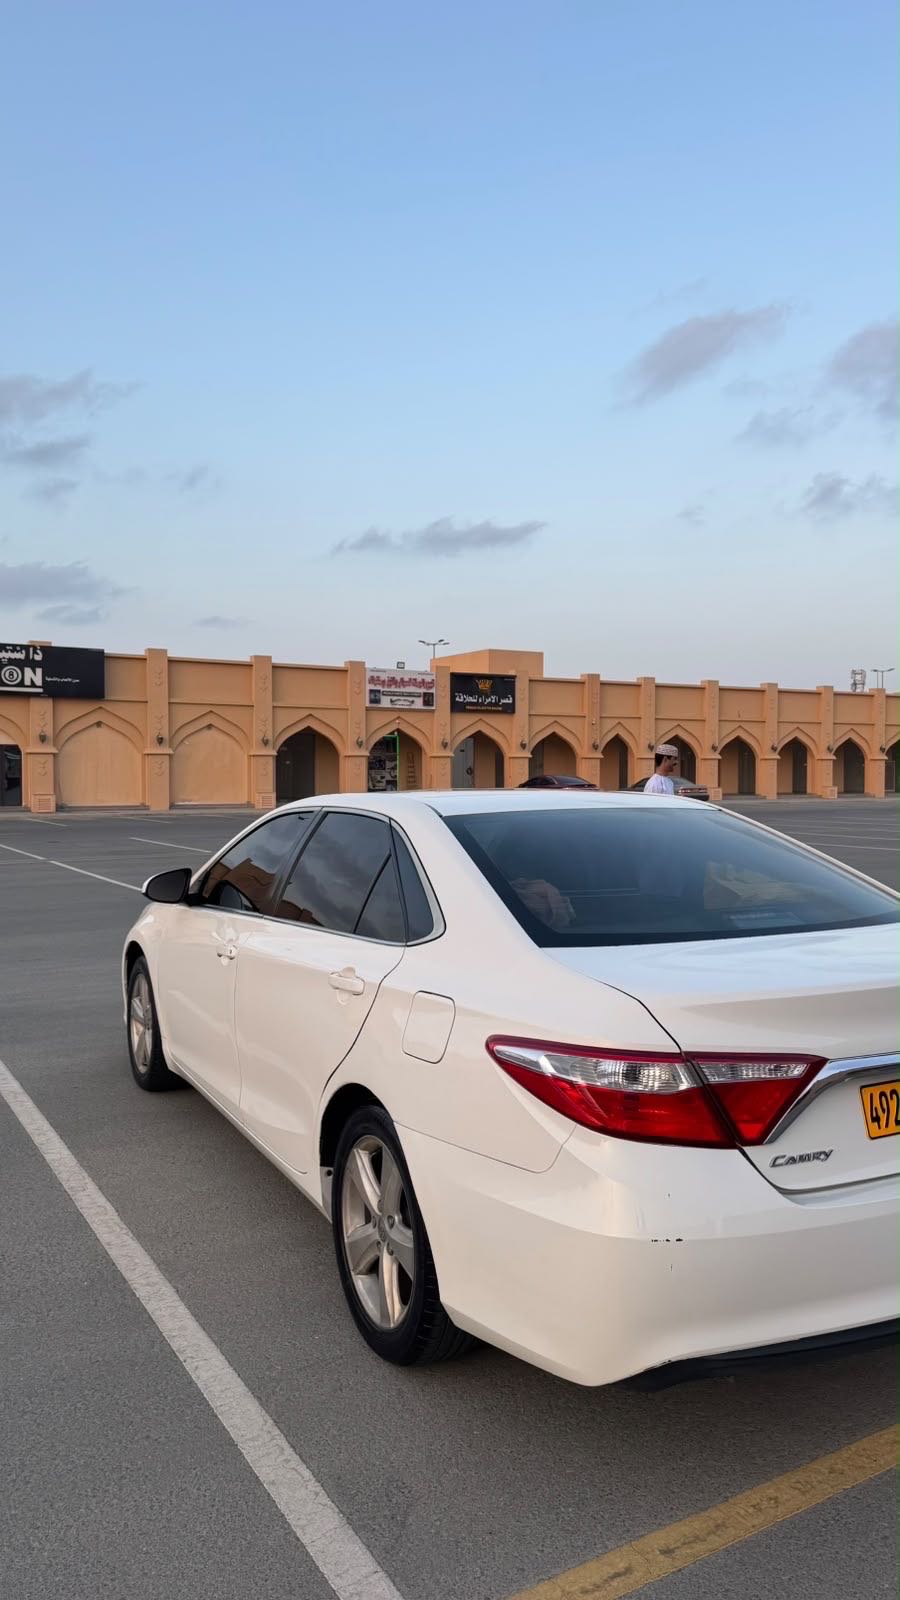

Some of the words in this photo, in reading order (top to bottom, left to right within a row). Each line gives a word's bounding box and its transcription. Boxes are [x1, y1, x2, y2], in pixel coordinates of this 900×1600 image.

[29, 646, 43, 661] ذا
[499, 694, 513, 705] قصر
[769, 1149, 834, 1168] CAMRY
